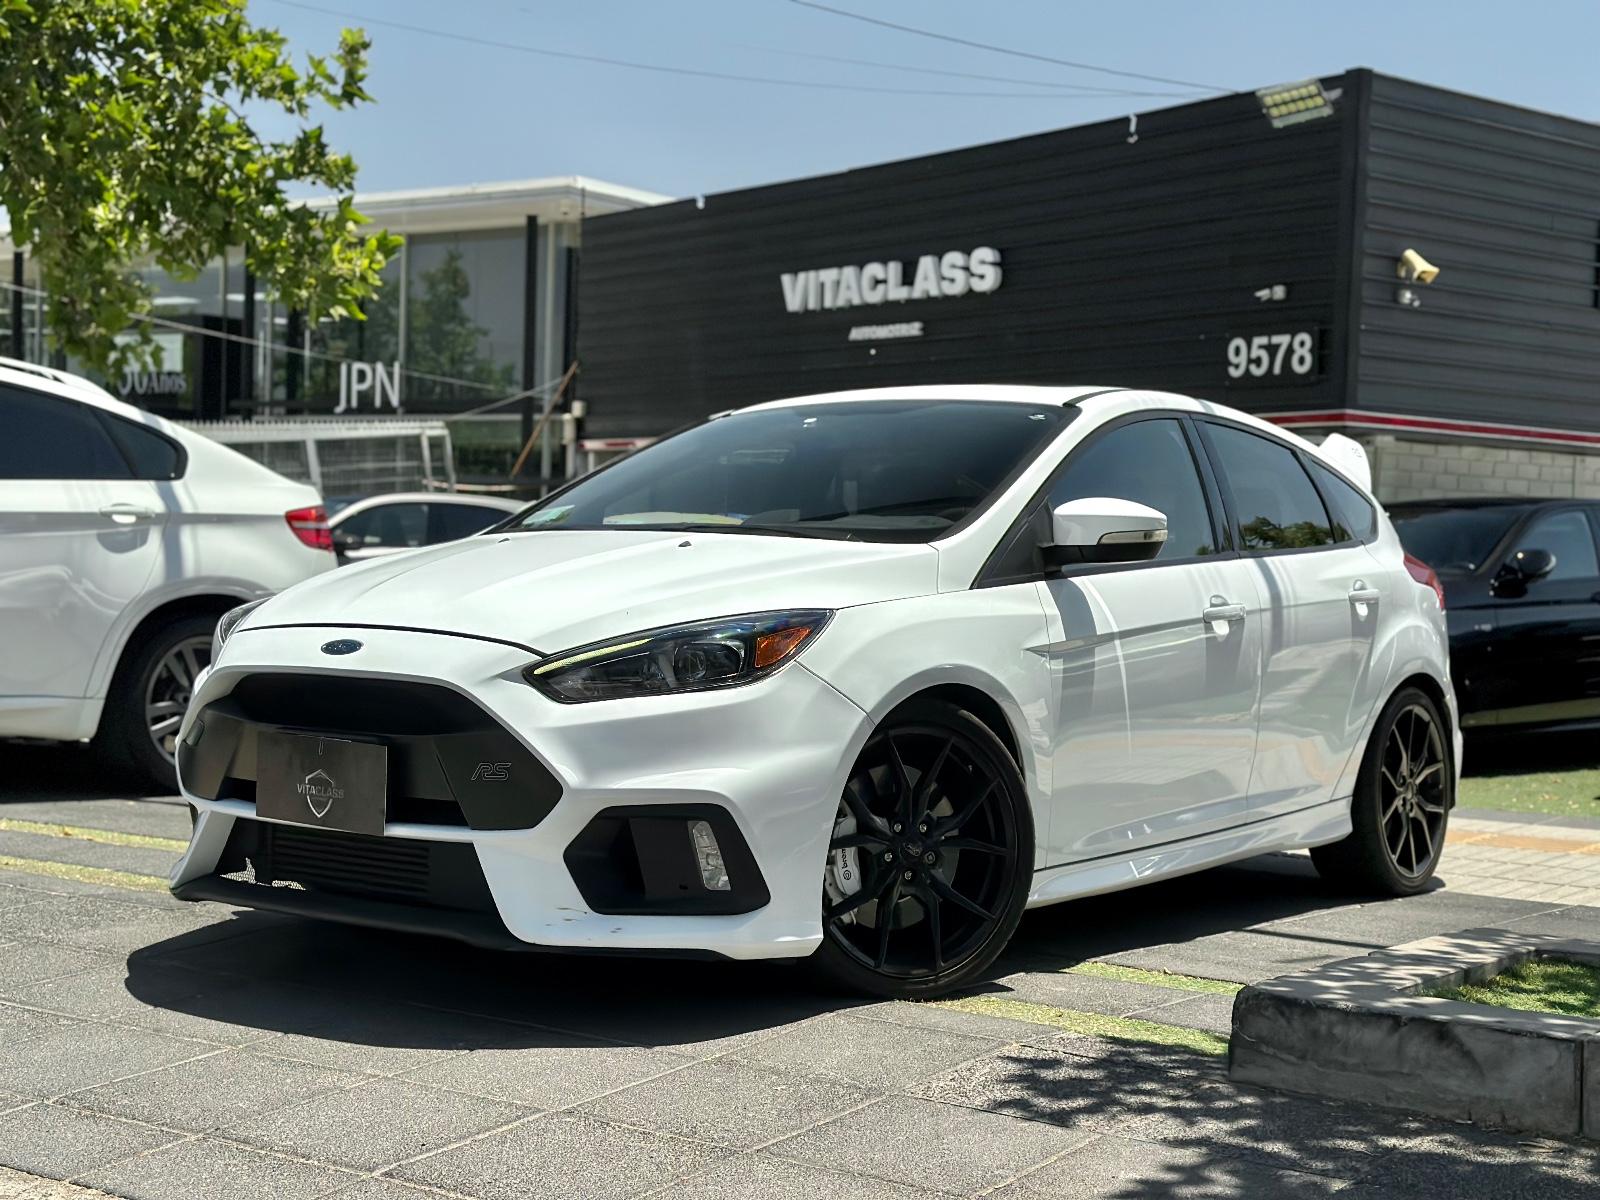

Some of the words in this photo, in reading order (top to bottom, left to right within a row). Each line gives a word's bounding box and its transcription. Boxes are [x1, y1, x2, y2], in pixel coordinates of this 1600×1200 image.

[780, 246, 1002, 314] VITACLASS
[1227, 331, 1313, 378] 9578
[333, 361, 400, 414] JPN
[296, 783, 345, 799] VITACLASS
[471, 762, 512, 781] RS
